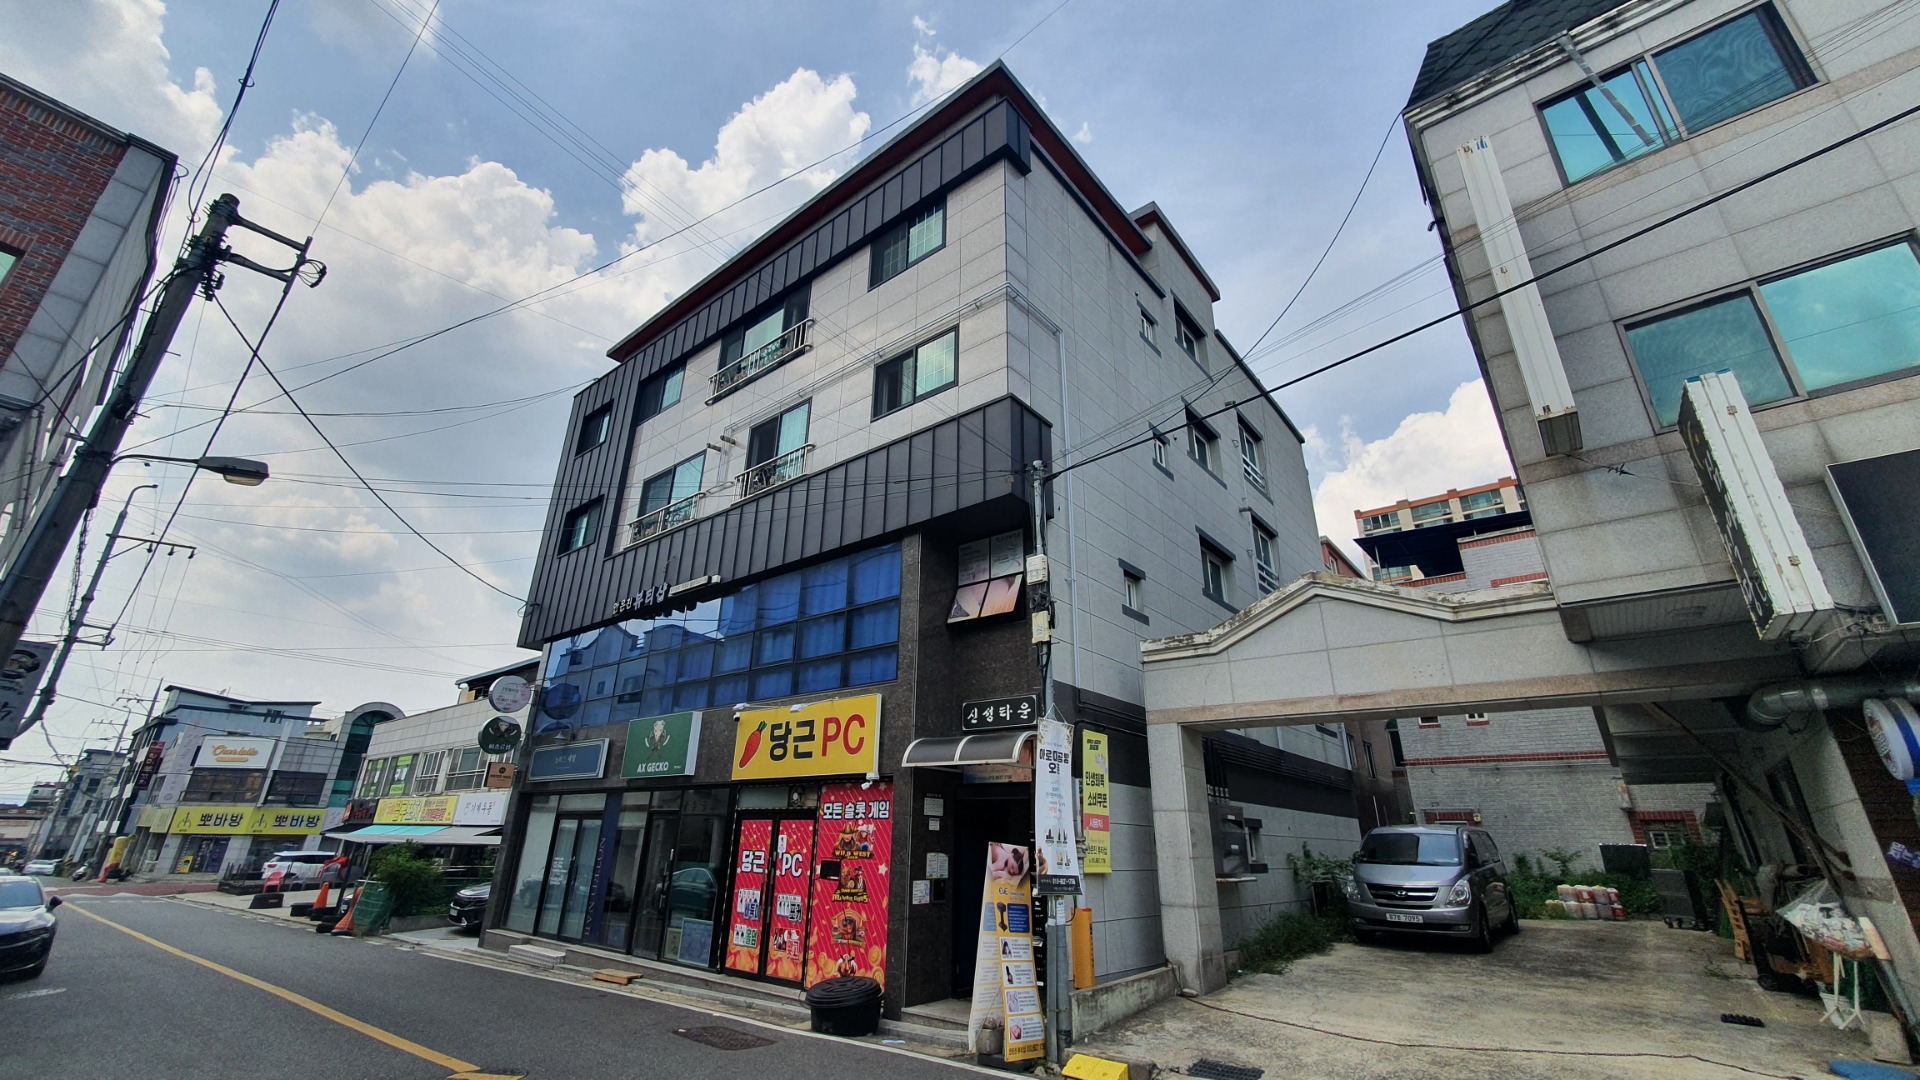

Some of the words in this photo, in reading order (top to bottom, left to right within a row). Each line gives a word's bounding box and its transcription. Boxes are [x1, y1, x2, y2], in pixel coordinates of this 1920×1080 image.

[632, 582, 668, 611] 뷰티샵
[967, 702, 1031, 724] 신성타운
[769, 719, 816, 762] 당근
[821, 714, 866, 757] PC
[636, 763, 646, 773] AX
[647, 761, 669, 773] GECKO
[1085, 771, 1105, 788] 민생회복
[822, 802, 843, 819] 모든
[844, 801, 866, 819] 슬롯
[868, 800, 890, 818] 게임
[1087, 793, 1108, 808] 소비쿠폰
[197, 813, 244, 827] 뽀바방
[272, 813, 321, 827] 뽀바방
[741, 850, 765, 873] 당근
[781, 853, 803, 877] PC
